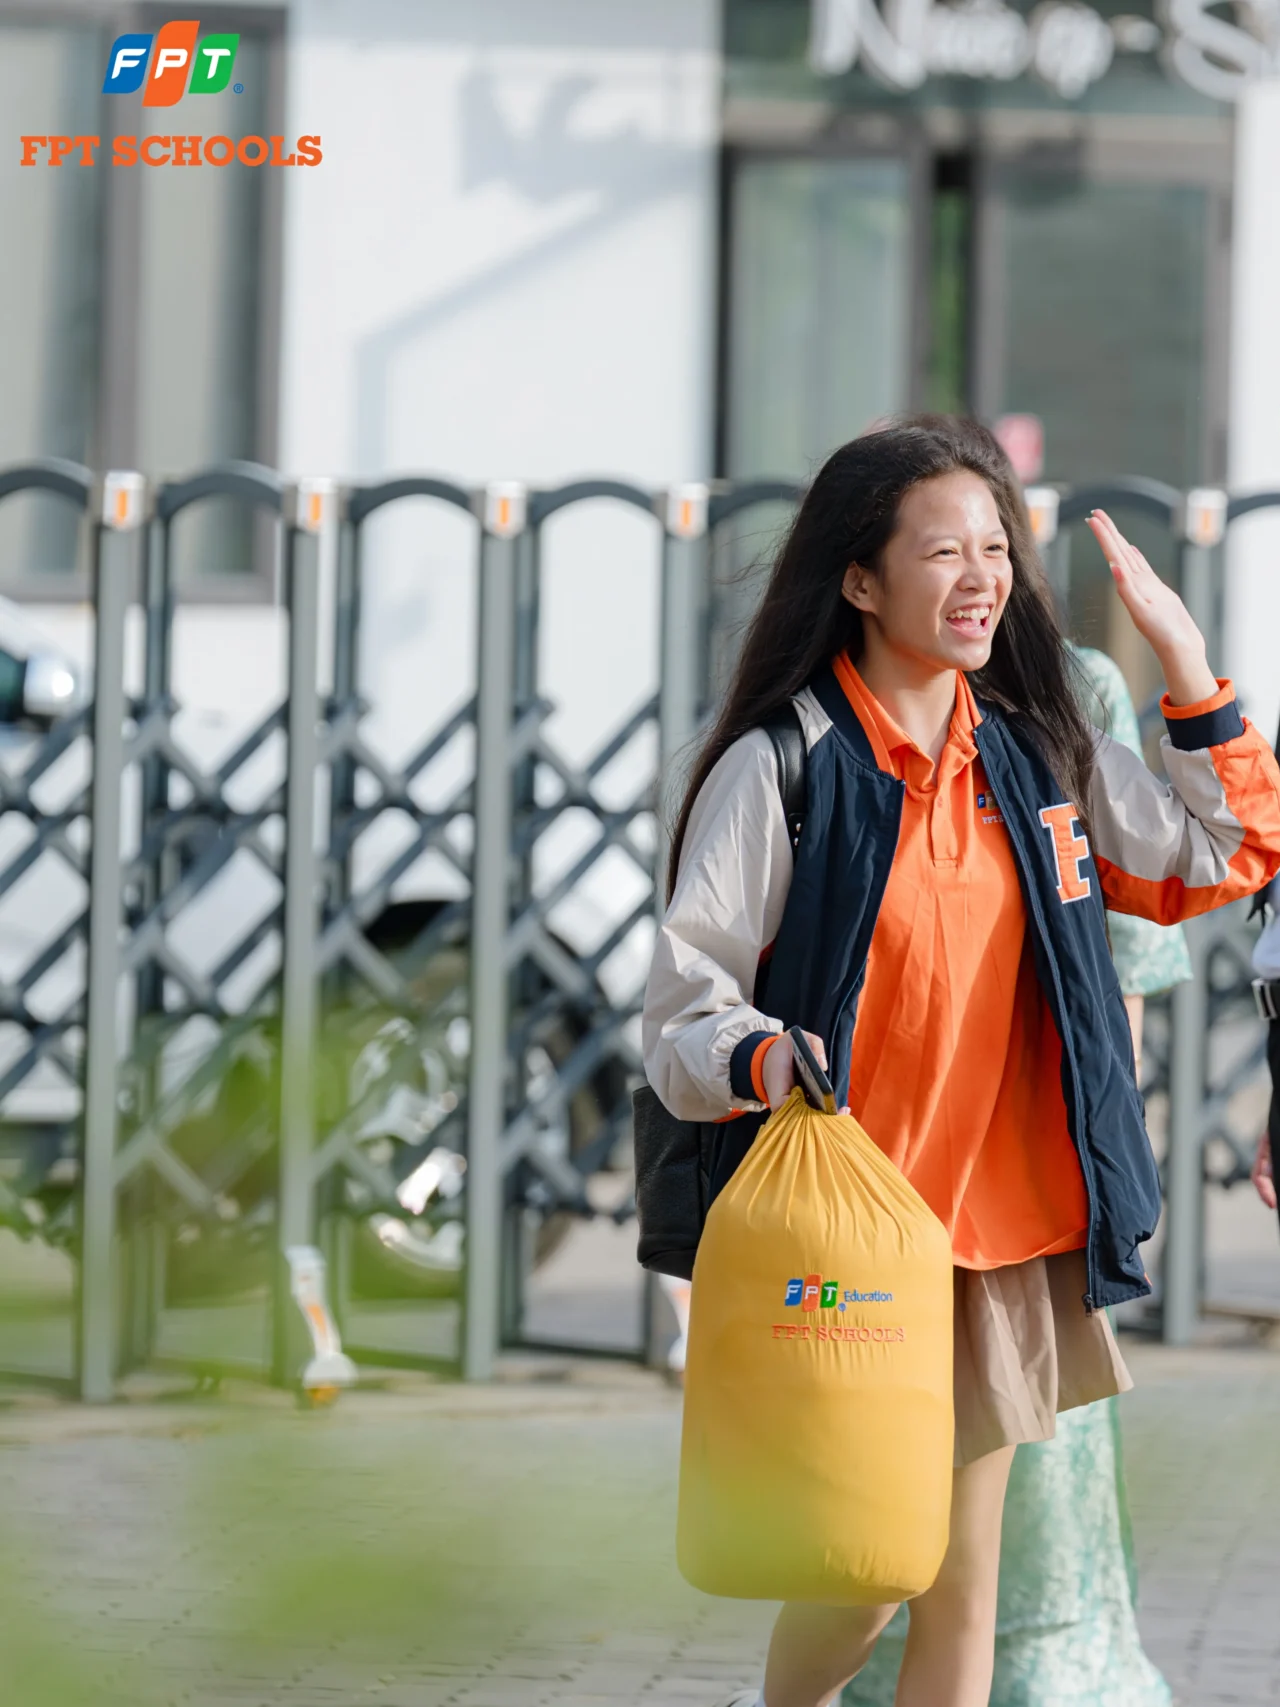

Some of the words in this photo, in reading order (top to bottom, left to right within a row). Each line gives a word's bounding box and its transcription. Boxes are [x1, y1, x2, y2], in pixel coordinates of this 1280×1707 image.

[785, 1284, 837, 1302] FPT
[844, 1289, 893, 1302] Education
[772, 1324, 812, 1340] FPT
[817, 1326, 905, 1342] SCHOOLS
